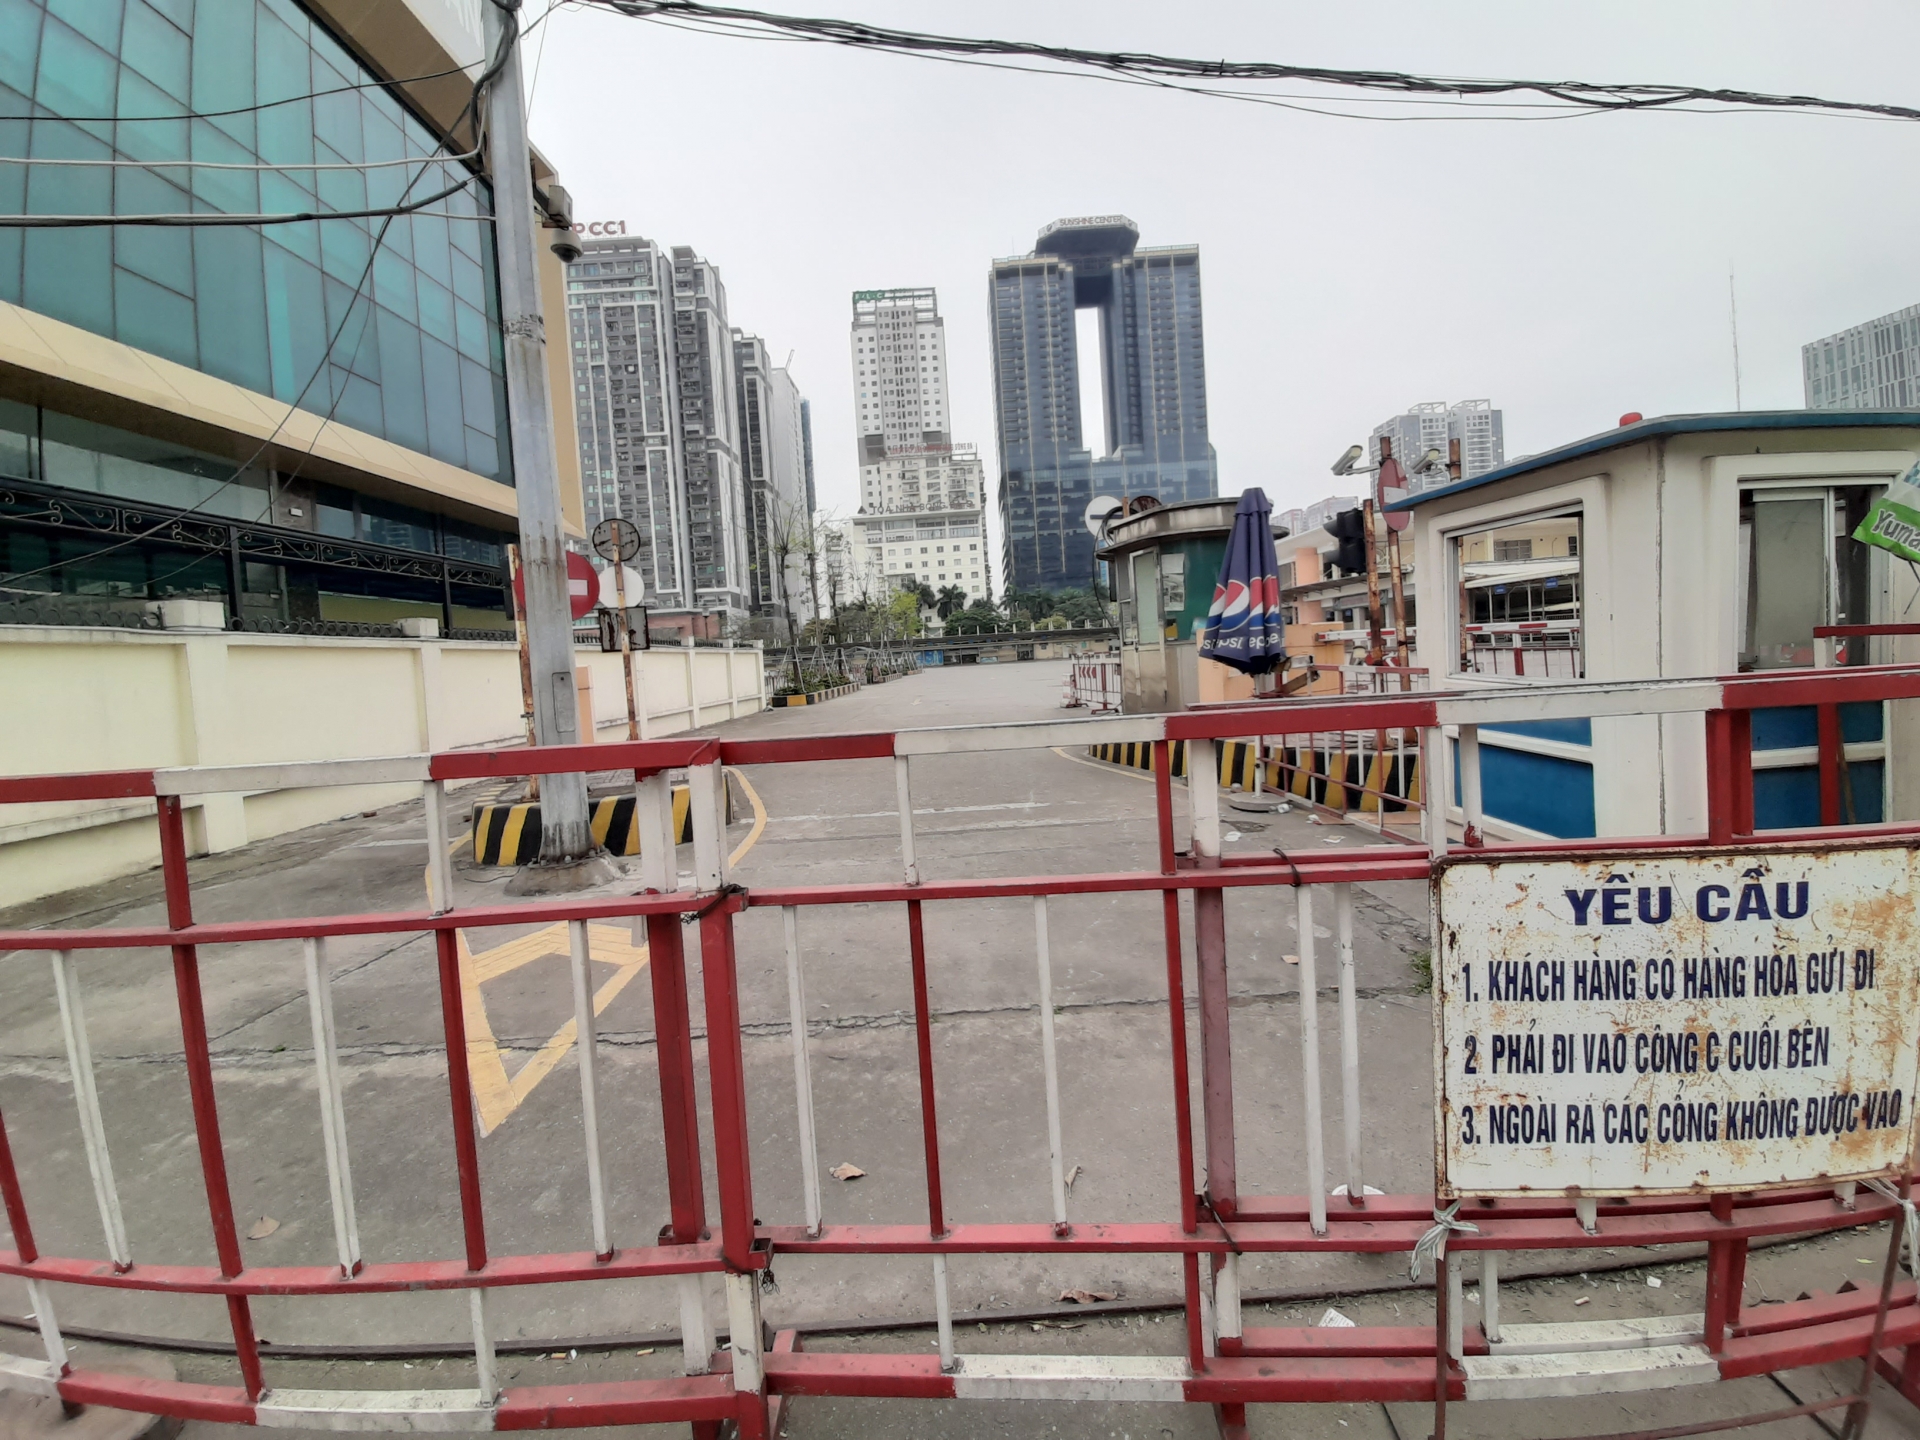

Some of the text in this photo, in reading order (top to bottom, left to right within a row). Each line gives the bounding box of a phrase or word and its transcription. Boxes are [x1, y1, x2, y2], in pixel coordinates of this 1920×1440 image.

[1060, 216, 1121, 226] SUNSHINE CENTER
[1564, 874, 1671, 925] YÊU
[1462, 934, 1875, 1002] 1. KHÁCH HÀNG CÓ HÀNG HÓA GỬI ĐI
[1492, 1018, 1543, 1074] PHẢI
[1552, 1034, 1574, 1073] ĐI
[1583, 1033, 1626, 1073] VAO
[1706, 1032, 1719, 1072] C
[1462, 1105, 1481, 1144] 3.
[1489, 1095, 1556, 1144] NGOÀI
[1566, 1104, 1595, 1143] RA
[1604, 1095, 1648, 1143] CÁC
[1657, 1079, 1717, 1143] CỔNG
[1726, 1092, 1798, 1140] KHÔNG
[1804, 1091, 1859, 1141] ĐƯỢC
